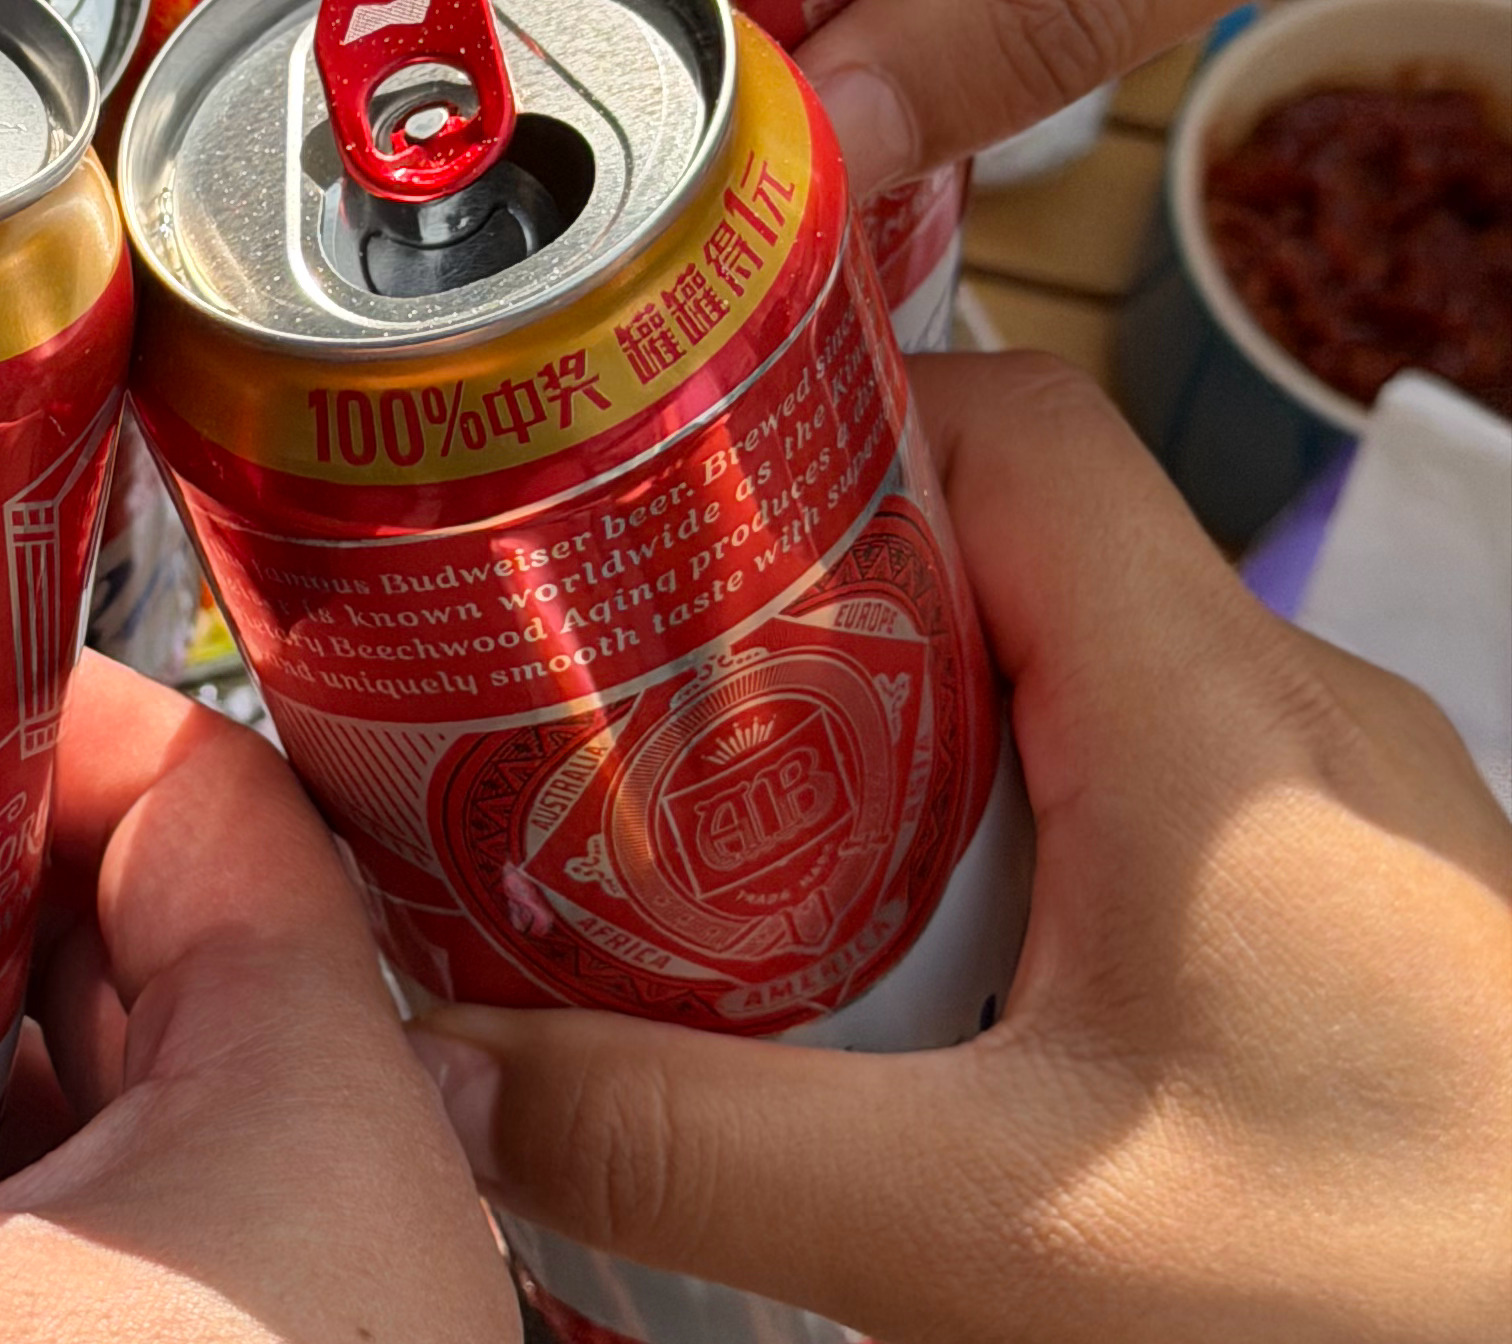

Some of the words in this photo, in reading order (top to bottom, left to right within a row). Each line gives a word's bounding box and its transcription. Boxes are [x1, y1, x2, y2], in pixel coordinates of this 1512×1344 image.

[309, 349, 612, 468] 100%中奖
[613, 151, 796, 386] 罐罐得1元
[328, 617, 548, 659] Beechwood
[559, 568, 677, 634] Aging
[690, 445, 831, 581] produces
[344, 601, 483, 628] known
[498, 501, 722, 612] worldwide
[734, 459, 772, 503] as
[784, 406, 827, 461] the
[381, 530, 592, 596] Budweiser
[602, 482, 696, 541] beer.
[702, 369, 812, 487] Brewed
[320, 669, 478, 700] uniquely
[490, 627, 638, 687] smooth
[652, 569, 744, 635] taste
[753, 504, 821, 574] with
[530, 740, 609, 833] AUSTRALIA
[575, 916, 674, 972] AFRICA
